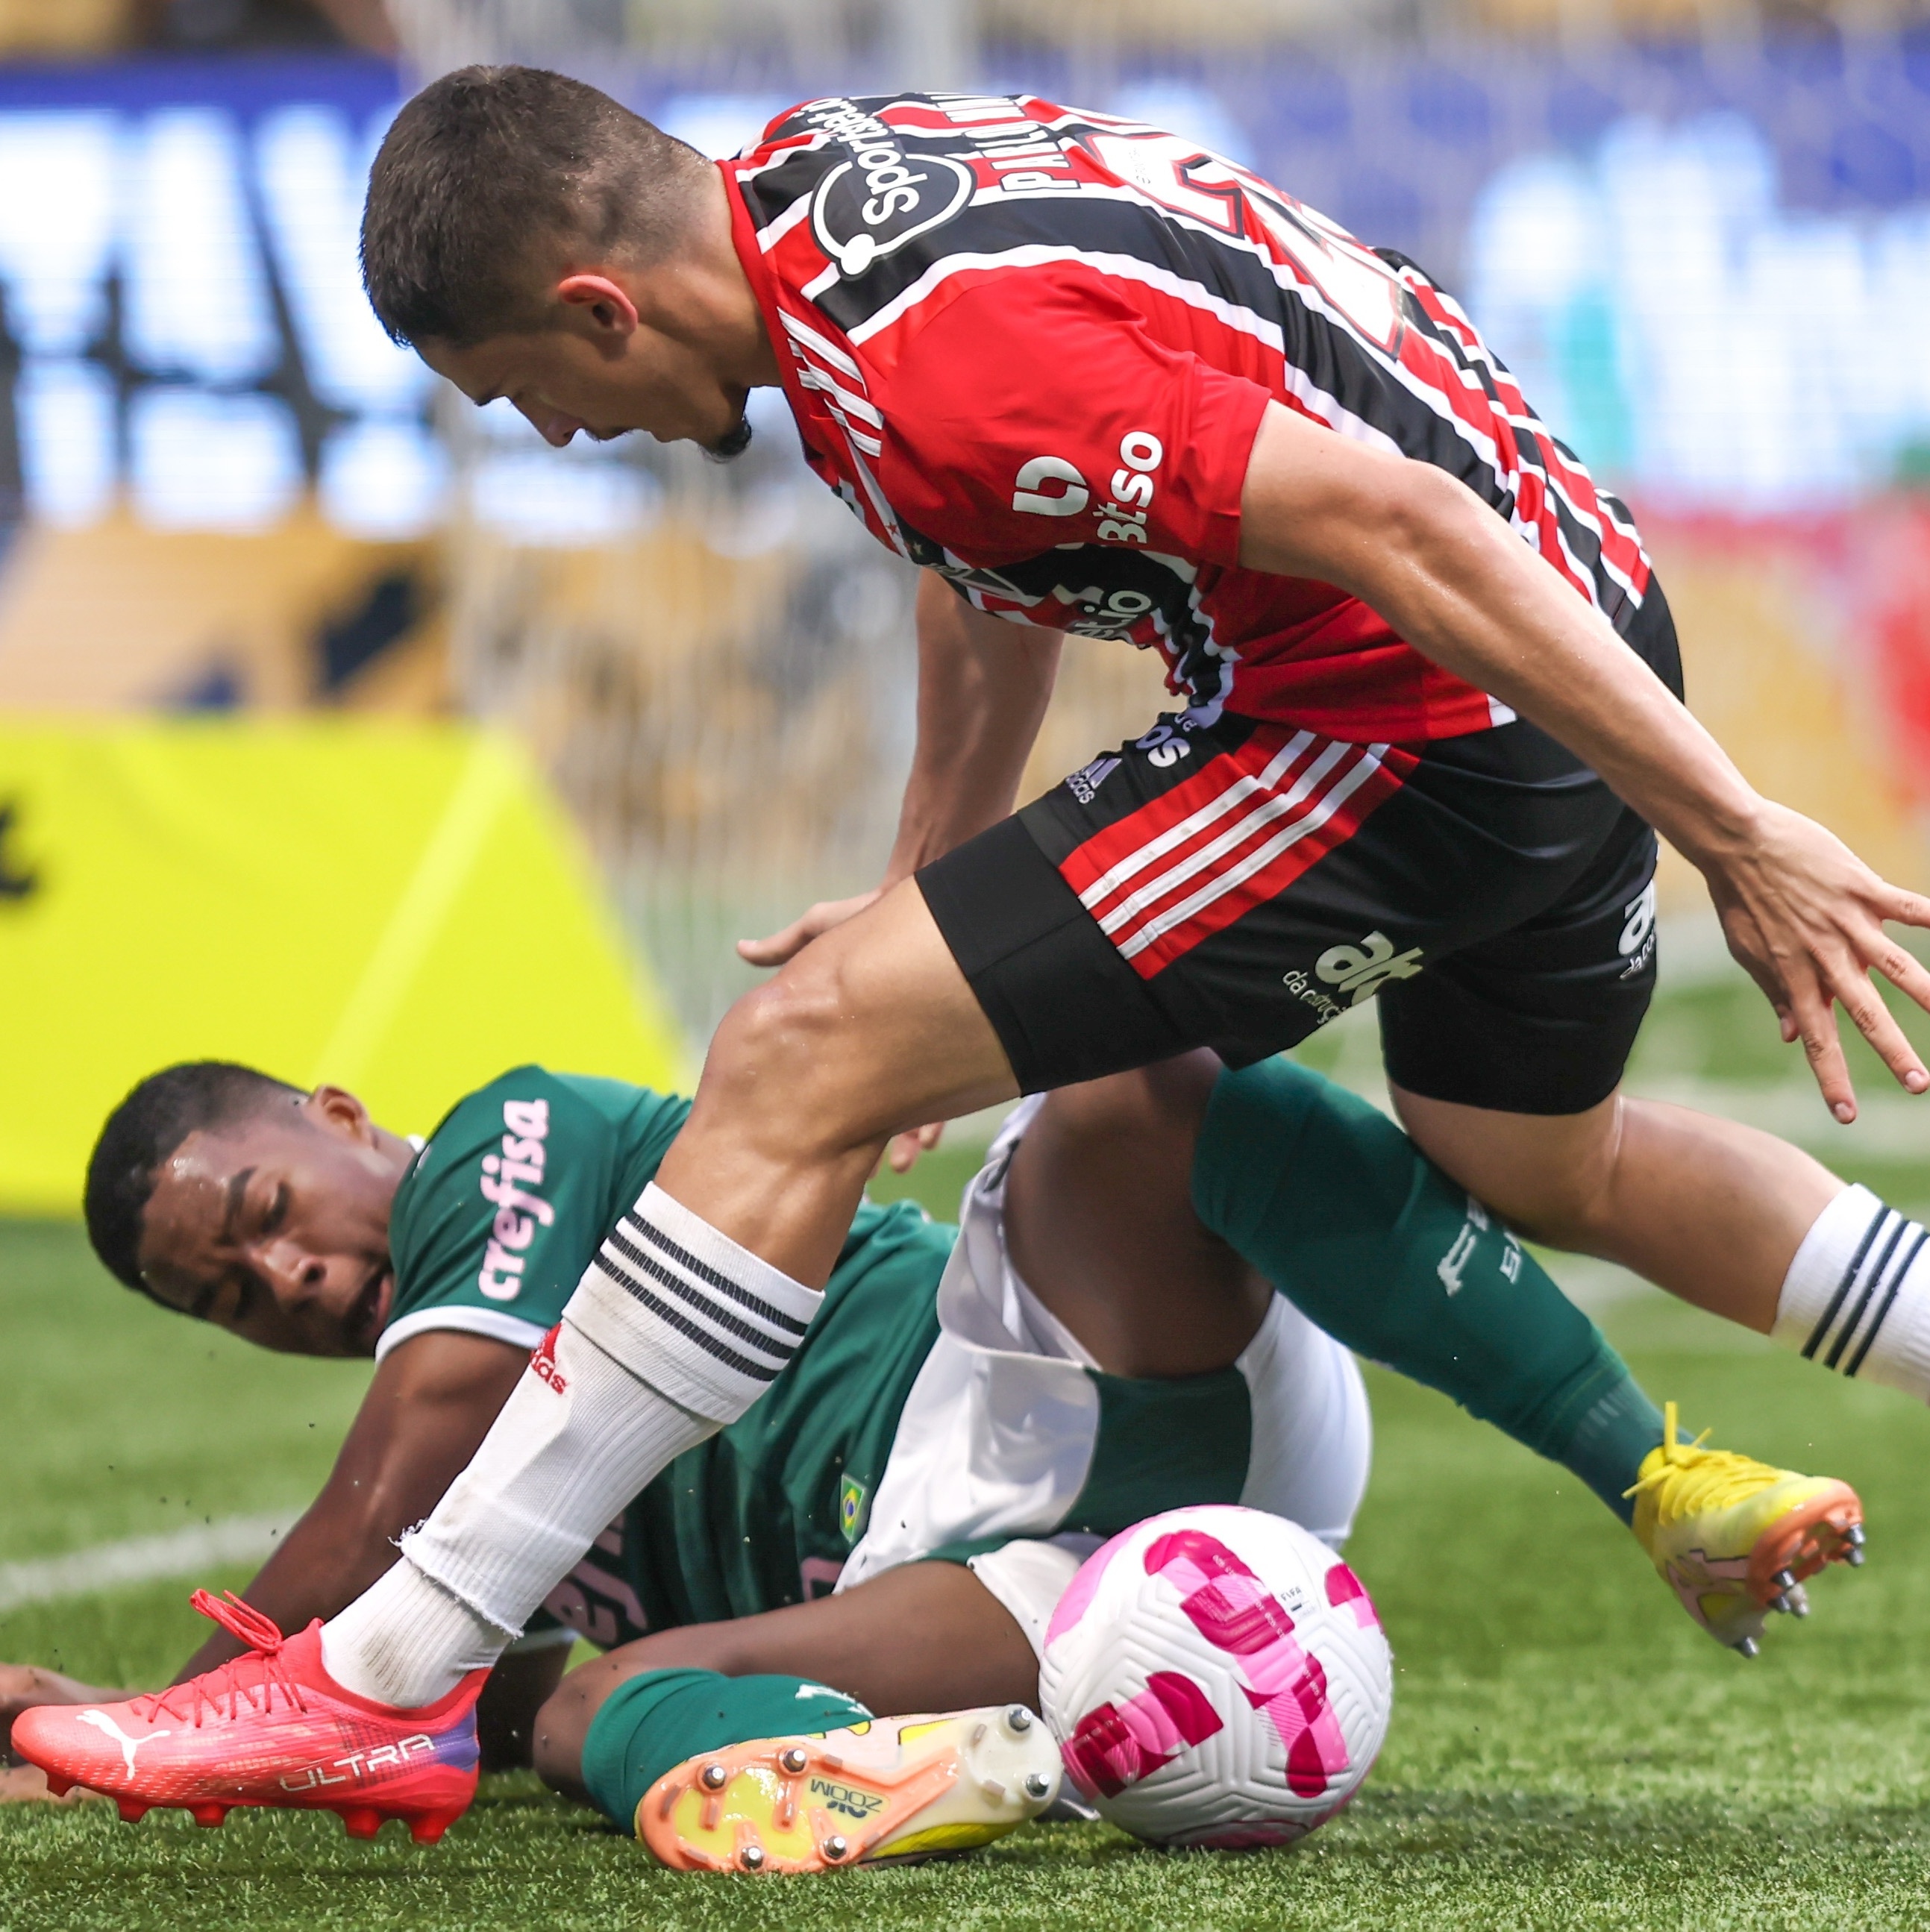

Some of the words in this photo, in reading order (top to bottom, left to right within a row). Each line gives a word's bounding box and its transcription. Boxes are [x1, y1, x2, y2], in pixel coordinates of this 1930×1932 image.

[964, 122, 1081, 192] PABLO
[1282, 970, 1309, 995] da
[477, 1098, 555, 1301] crefisa
[1280, 1586, 1303, 1602] FIFA
[279, 1734, 436, 1792] ULTRA
[810, 1778, 883, 1813] ZOOM
